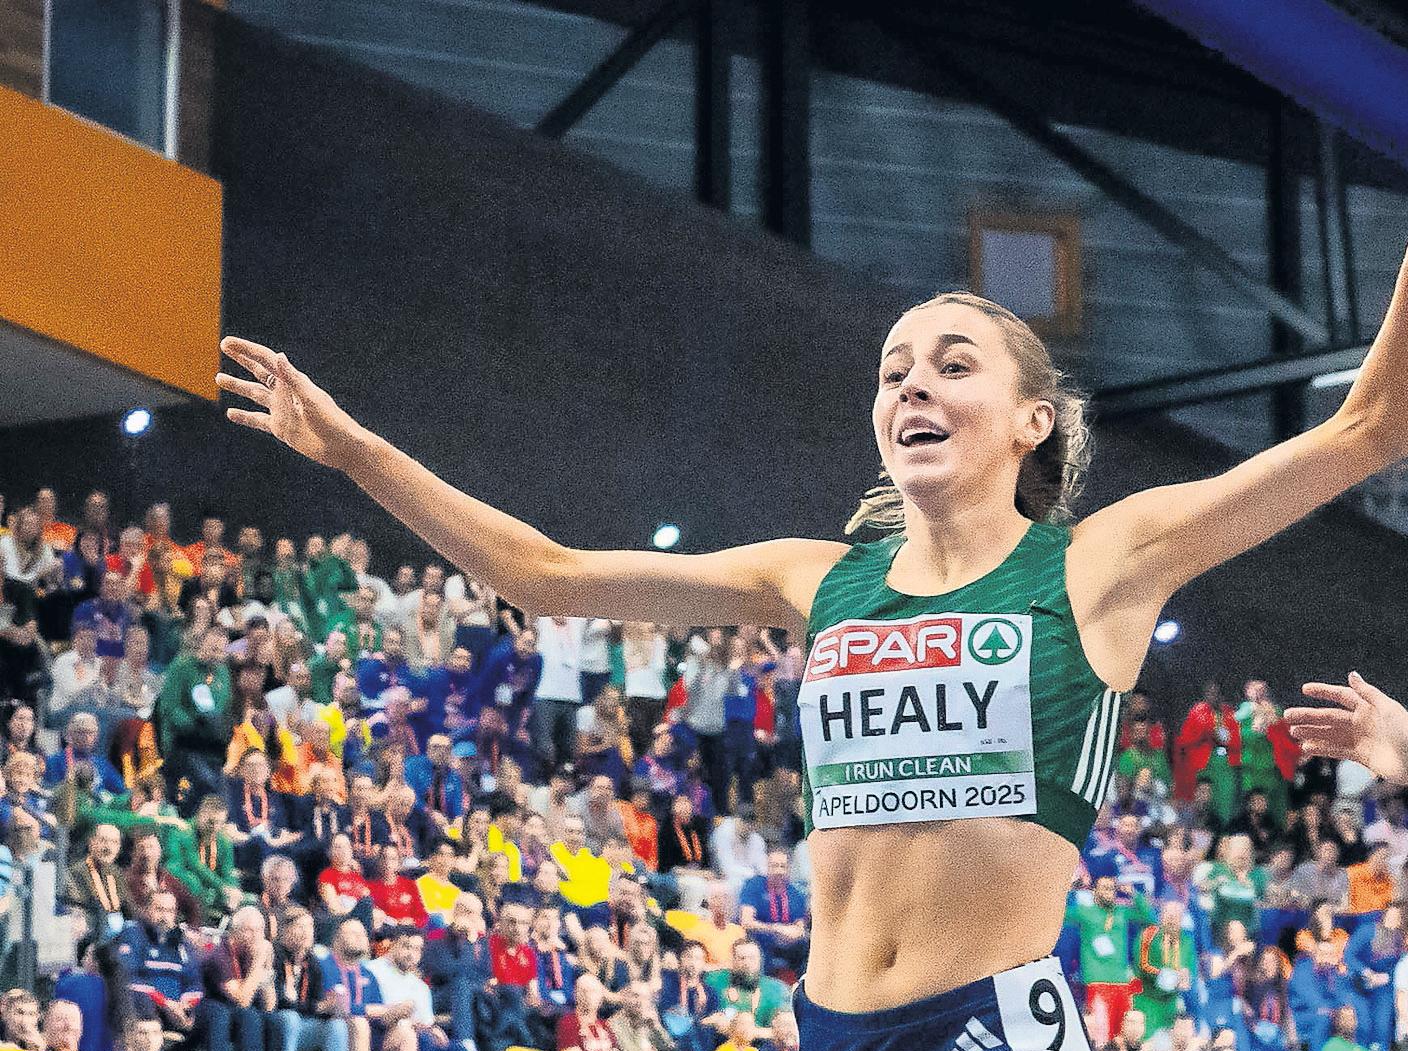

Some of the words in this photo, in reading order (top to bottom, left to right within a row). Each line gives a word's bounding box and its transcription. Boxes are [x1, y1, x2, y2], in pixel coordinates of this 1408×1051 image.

[811, 623, 958, 675] SPAR
[819, 680, 999, 742] HEALY
[845, 764, 851, 782] I
[853, 761, 894, 781] RUN
[898, 756, 972, 776] CLEAN
[818, 788, 957, 818] APELDOORN
[965, 783, 1026, 806] 2025
